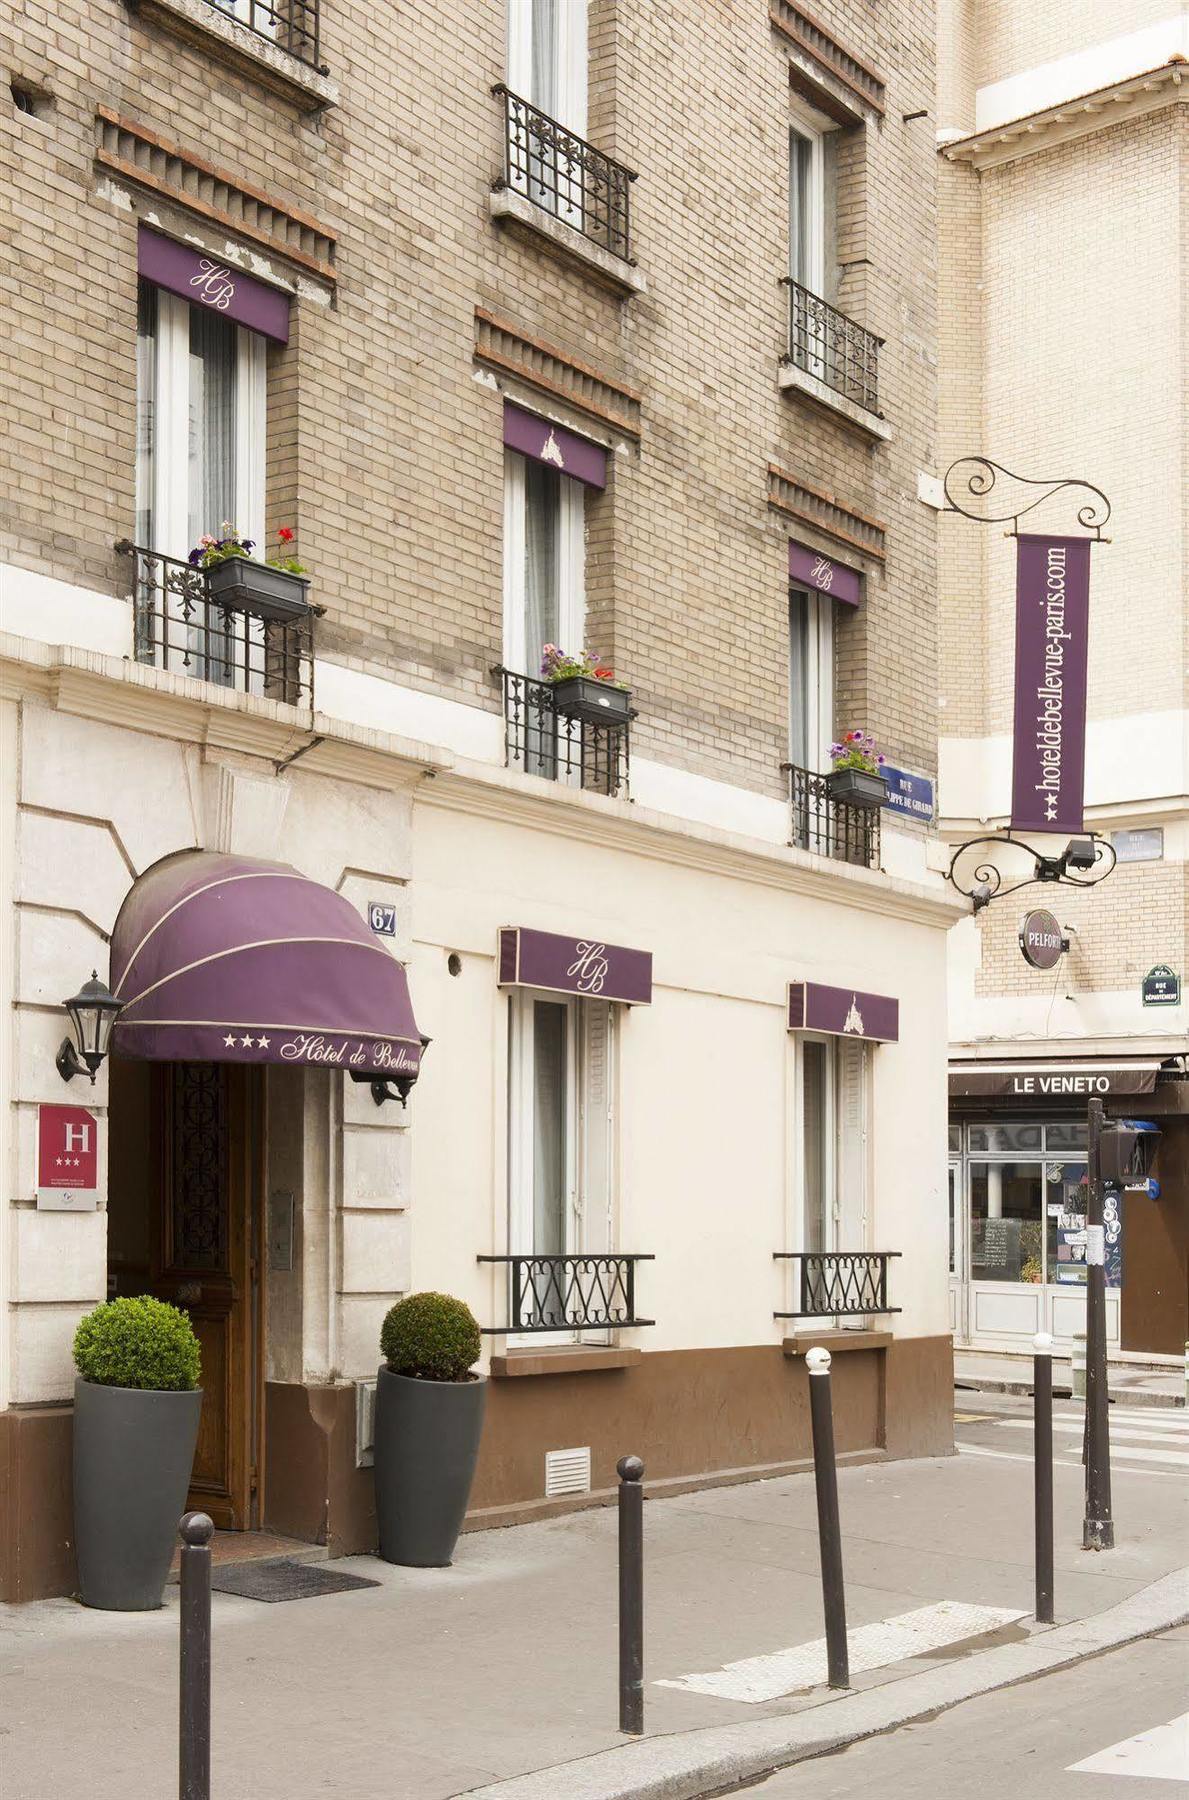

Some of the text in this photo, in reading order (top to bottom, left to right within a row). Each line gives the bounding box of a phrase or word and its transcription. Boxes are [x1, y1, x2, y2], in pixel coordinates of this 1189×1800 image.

[1035, 547, 1071, 792] hoteldebellevue-paris.com
[899, 779, 913, 792] RUE
[372, 906, 394, 931] 67
[280, 1035, 348, 1064] Hôtel
[349, 1043, 366, 1065] de
[1014, 1076, 1110, 1093] LE VENETO
[64, 1122, 91, 1153] H
